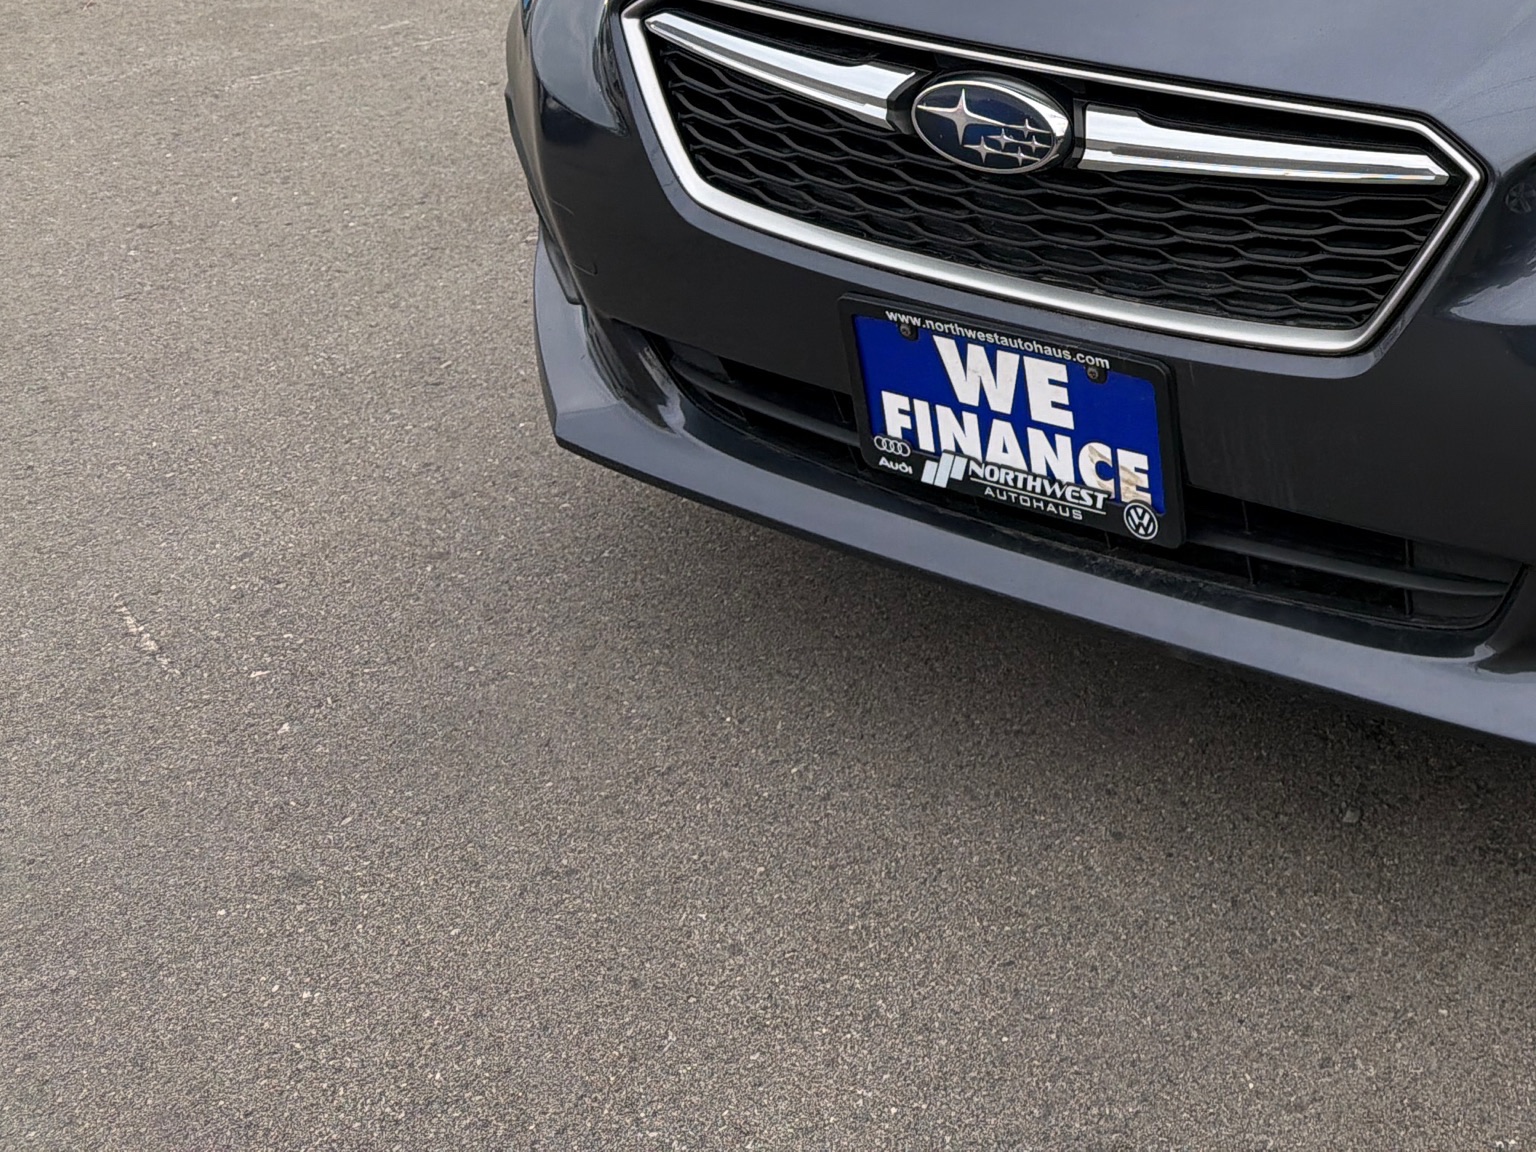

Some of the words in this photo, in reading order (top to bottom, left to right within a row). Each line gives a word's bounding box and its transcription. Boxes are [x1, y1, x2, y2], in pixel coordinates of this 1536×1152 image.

[885, 310, 1110, 370] www.northwestautohaus.com
[932, 334, 1075, 430] WE
[878, 456, 913, 475] Audi
[881, 390, 1152, 505] FINANCE
[968, 462, 1111, 510] NORTHWEST
[983, 486, 1084, 521] AUTOHAUS
